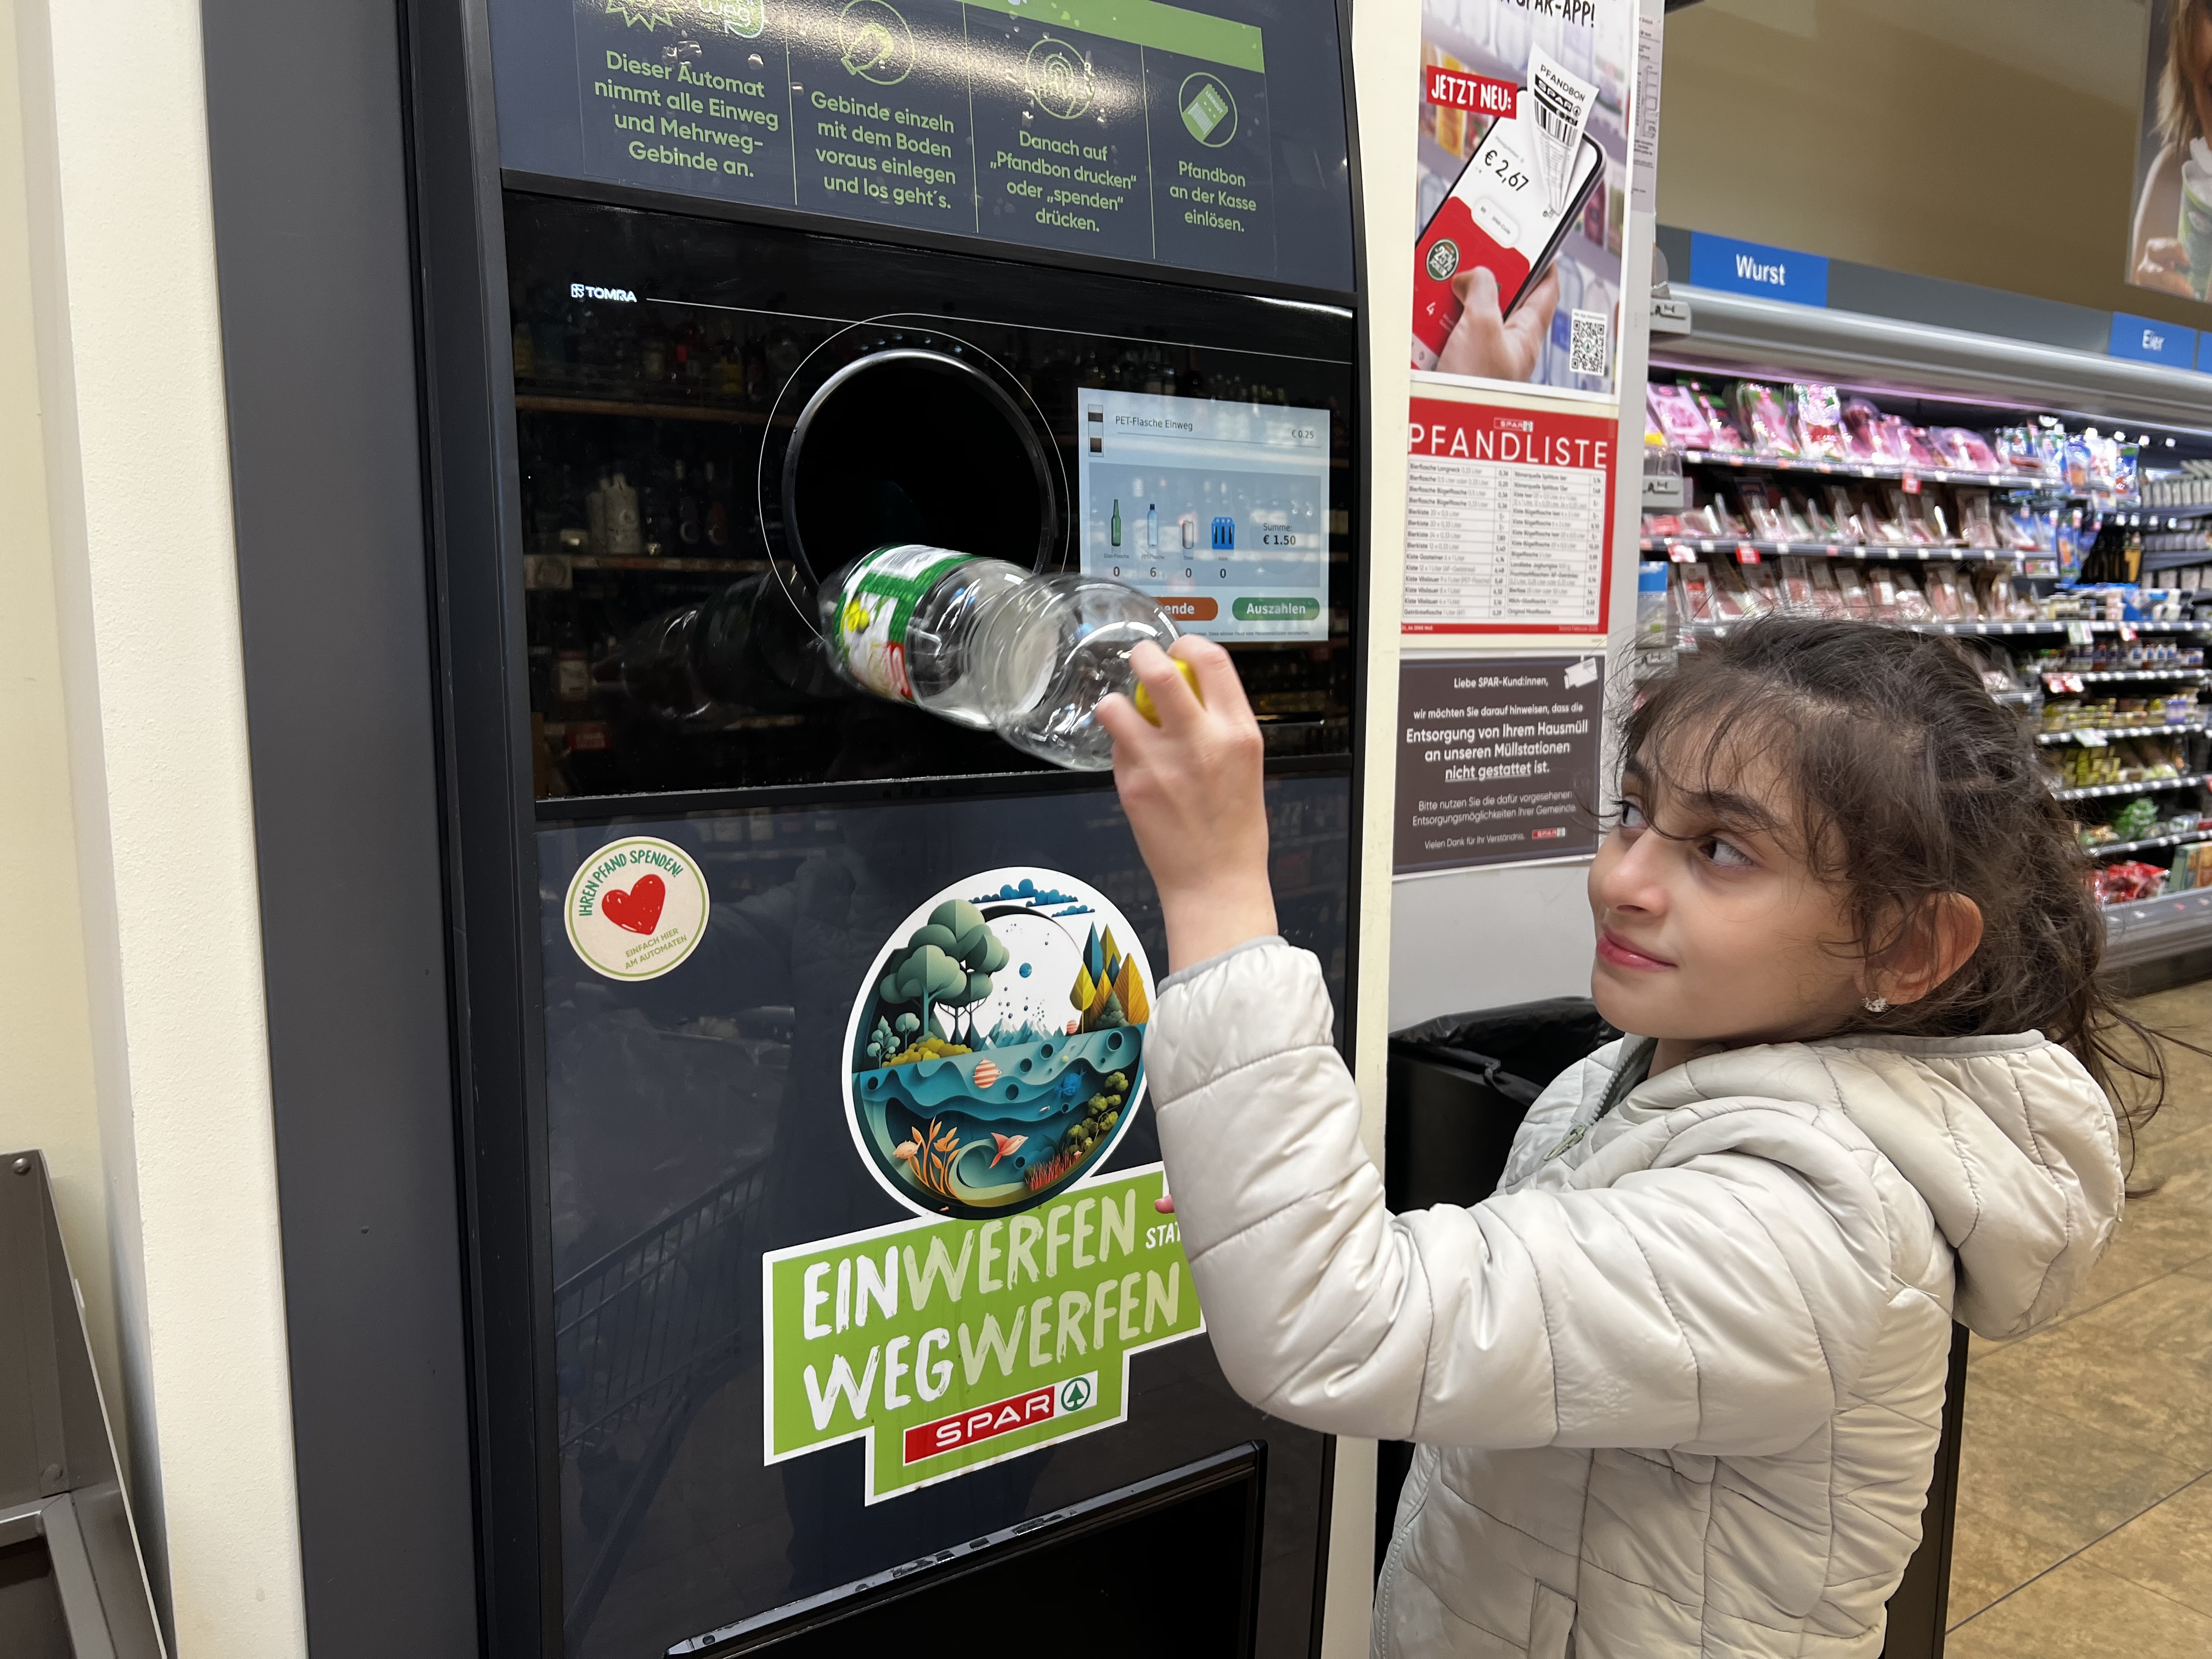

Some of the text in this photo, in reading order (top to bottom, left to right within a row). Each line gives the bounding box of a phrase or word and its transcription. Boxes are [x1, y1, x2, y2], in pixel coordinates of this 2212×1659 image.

[607, 50, 764, 97] Dieser Automat
[1541, 64, 1585, 102] PFANDBON
[595, 78, 778, 132] nimmt alle Einweg
[1431, 74, 1511, 112] JETZT NEU:
[1538, 80, 1573, 112] SPAR
[811, 91, 954, 133] Gebinde einzeln
[615, 114, 763, 155] und Mehrweg-
[818, 120, 951, 158] mit dem Boden
[1019, 129, 1108, 161] Danach auf
[629, 140, 754, 178] Gebinde an.
[816, 149, 956, 185] voraus einlegen
[990, 151, 1137, 190] „Pfandbon drucken“
[1485, 150, 1529, 191] € 2,67
[1179, 160, 1246, 187] Pfandbon
[825, 176, 951, 208] und los geht´s.
[1007, 179, 1124, 211] oder „spenden“
[1170, 185, 1256, 211] an der Kasse
[1036, 207, 1099, 232] drücken.
[1185, 209, 1244, 232] einlösen.
[1735, 253, 1786, 286] Wurst
[585, 286, 637, 302] TOMRA
[2142, 329, 2166, 352] Eier
[1115, 416, 1193, 431] PET-Flasche Einweg
[1298, 430, 1314, 439] 0.25
[1500, 420, 1523, 429] SPAR
[1408, 423, 1608, 469] PFANDLISTE
[1263, 523, 1293, 532] Summe:
[1263, 535, 1296, 545] € 1.50
[1114, 566, 1120, 577] 0
[1150, 567, 1156, 577] 6
[1186, 567, 1192, 578] 0
[1220, 568, 1226, 578] 0
[1246, 602, 1306, 614] Auszahlen
[1454, 675, 1548, 689] Liebe SPAR-Kund:innen,
[1414, 702, 1583, 719] wir möchten Sie darauf hinweisen, dass die
[1407, 719, 1588, 743] Entsorgung von Ihrem Hausmüll
[1425, 741, 1570, 762] an unseren Müllstationen
[1446, 760, 1550, 781] nicht gestattet ist.
[1419, 791, 1572, 811] Bitte nutzen Sie die dafür vorgesehenen
[1413, 808, 1516, 827] Entsorgungsmöglichkeiten
[1518, 807, 1534, 817] Ihrer
[1425, 839, 1445, 849] Vielen
[1447, 837, 1464, 848] Dank
[1466, 836, 1475, 845] für
[579, 850, 684, 916] IHREN PFAND SPENDEN!
[625, 927, 679, 957] EINFACH HIER
[625, 934, 687, 970] AM AUTOMATEN
[803, 1188, 1136, 1340] EINWERFEN
[803, 1262, 1180, 1431] WEGWERFEN
[935, 1394, 1050, 1448] SPAR
